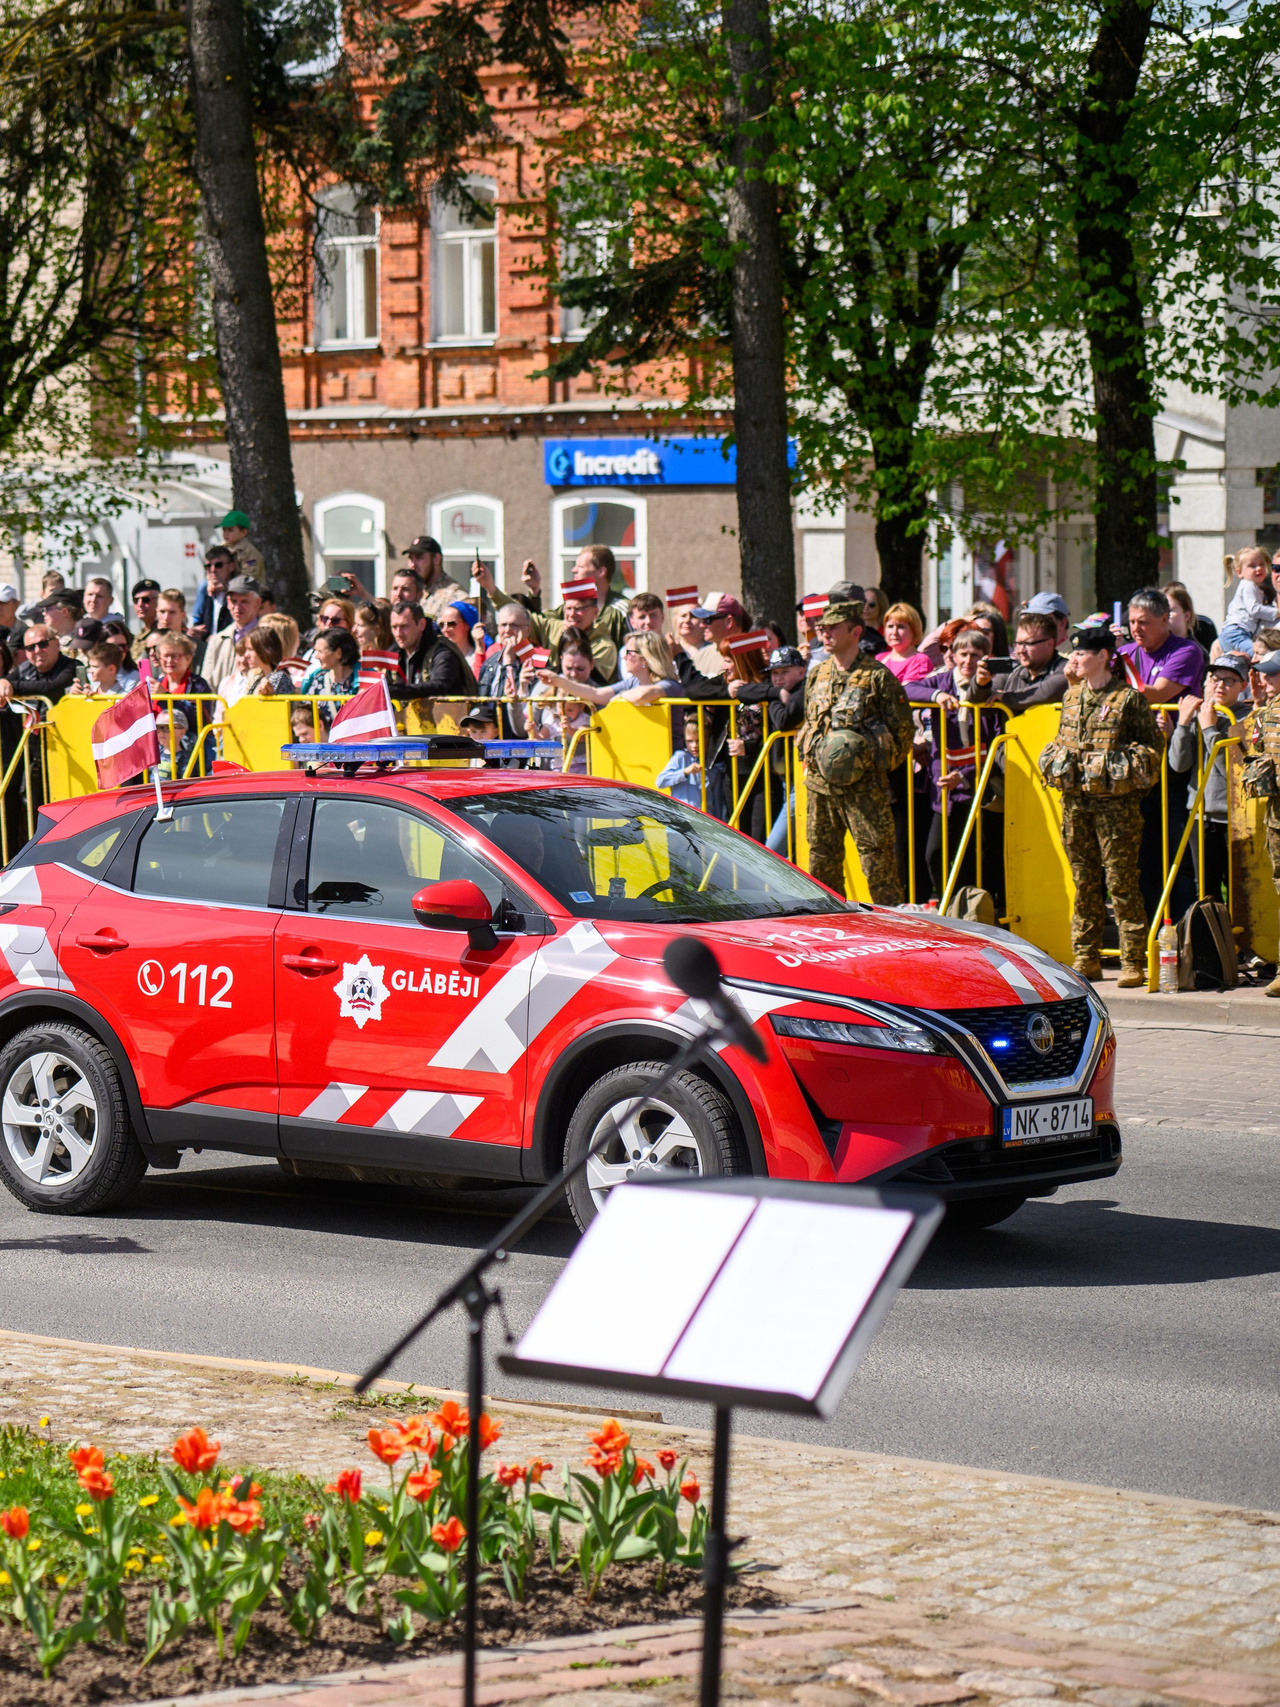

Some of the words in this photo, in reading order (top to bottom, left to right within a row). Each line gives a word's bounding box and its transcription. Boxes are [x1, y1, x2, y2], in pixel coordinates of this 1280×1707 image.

[574, 447, 661, 476] Incredit
[766, 927, 864, 946] 112
[169, 962, 234, 1009] 112
[391, 967, 480, 998] GLĀBĒJI
[85, 1059, 108, 1110] YOKOHAMA
[1015, 1102, 1090, 1136] NK-8714
